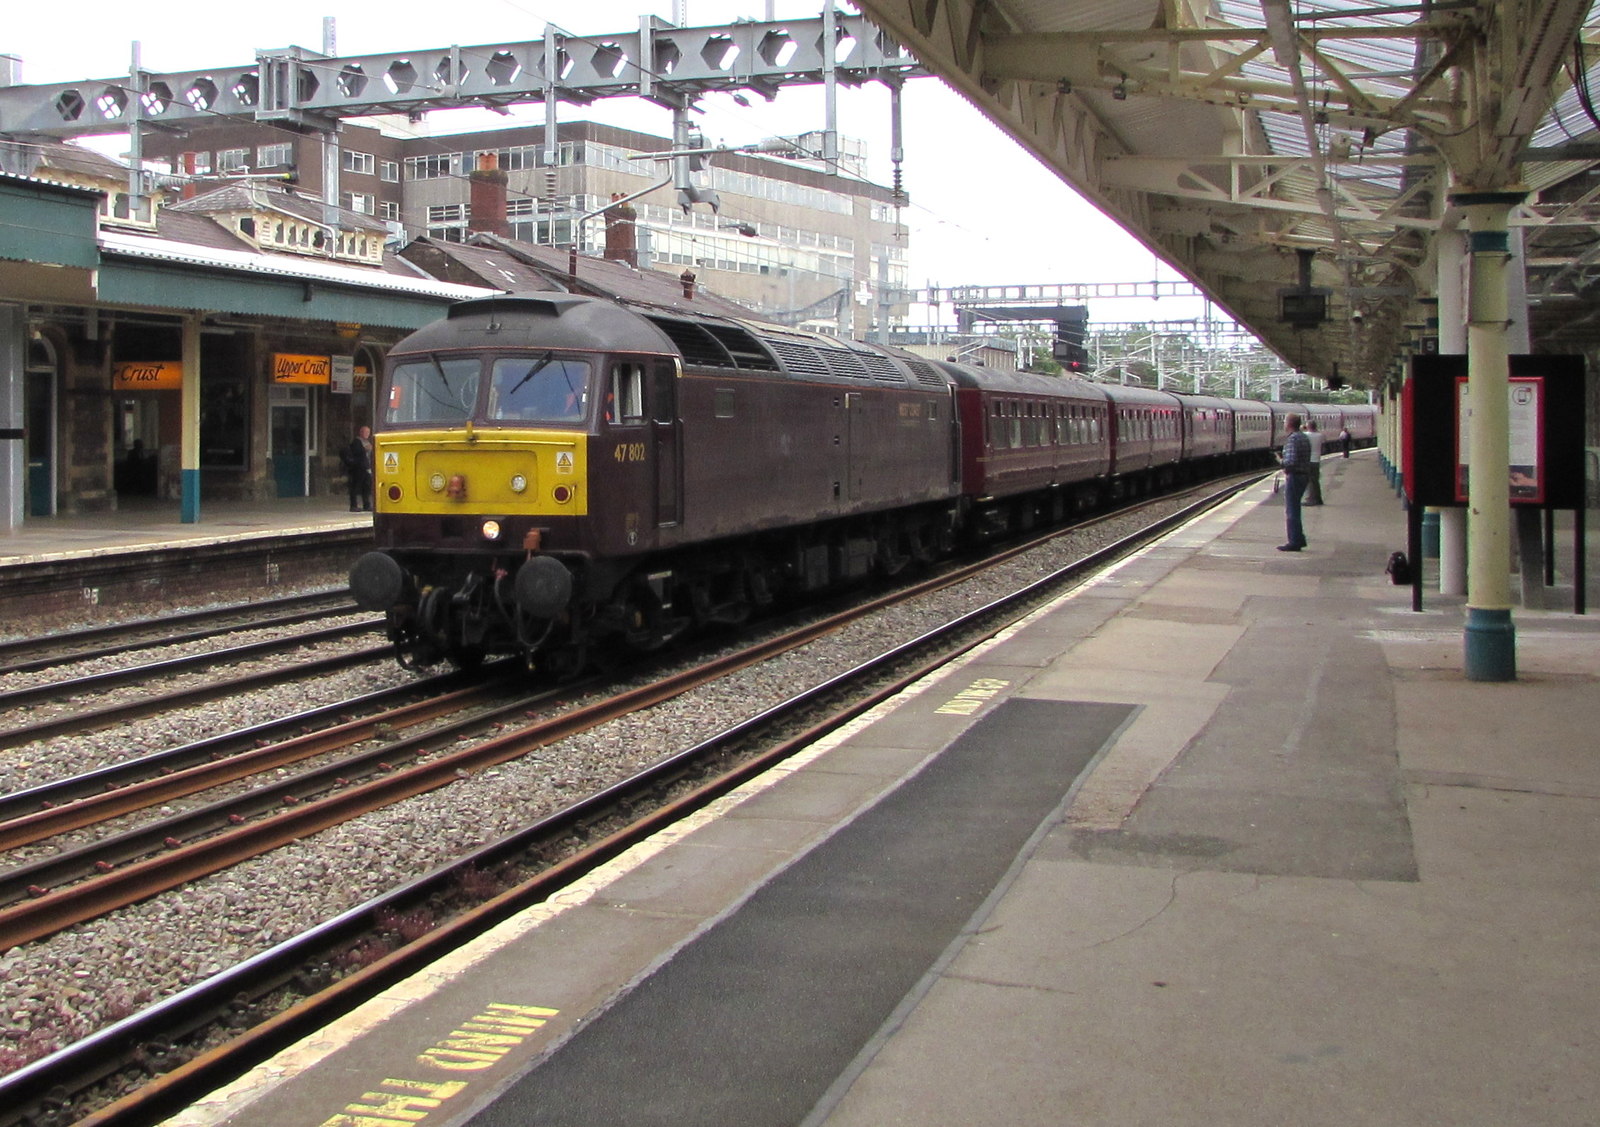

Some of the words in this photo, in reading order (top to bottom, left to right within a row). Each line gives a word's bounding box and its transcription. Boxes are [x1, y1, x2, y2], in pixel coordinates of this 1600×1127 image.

[120, 364, 165, 381] Crust
[276, 358, 303, 378] Upper
[303, 359, 328, 375] Crust
[614, 443, 627, 462] 47
[628, 442, 645, 461] 802
[416, 1002, 560, 1071] MIND
